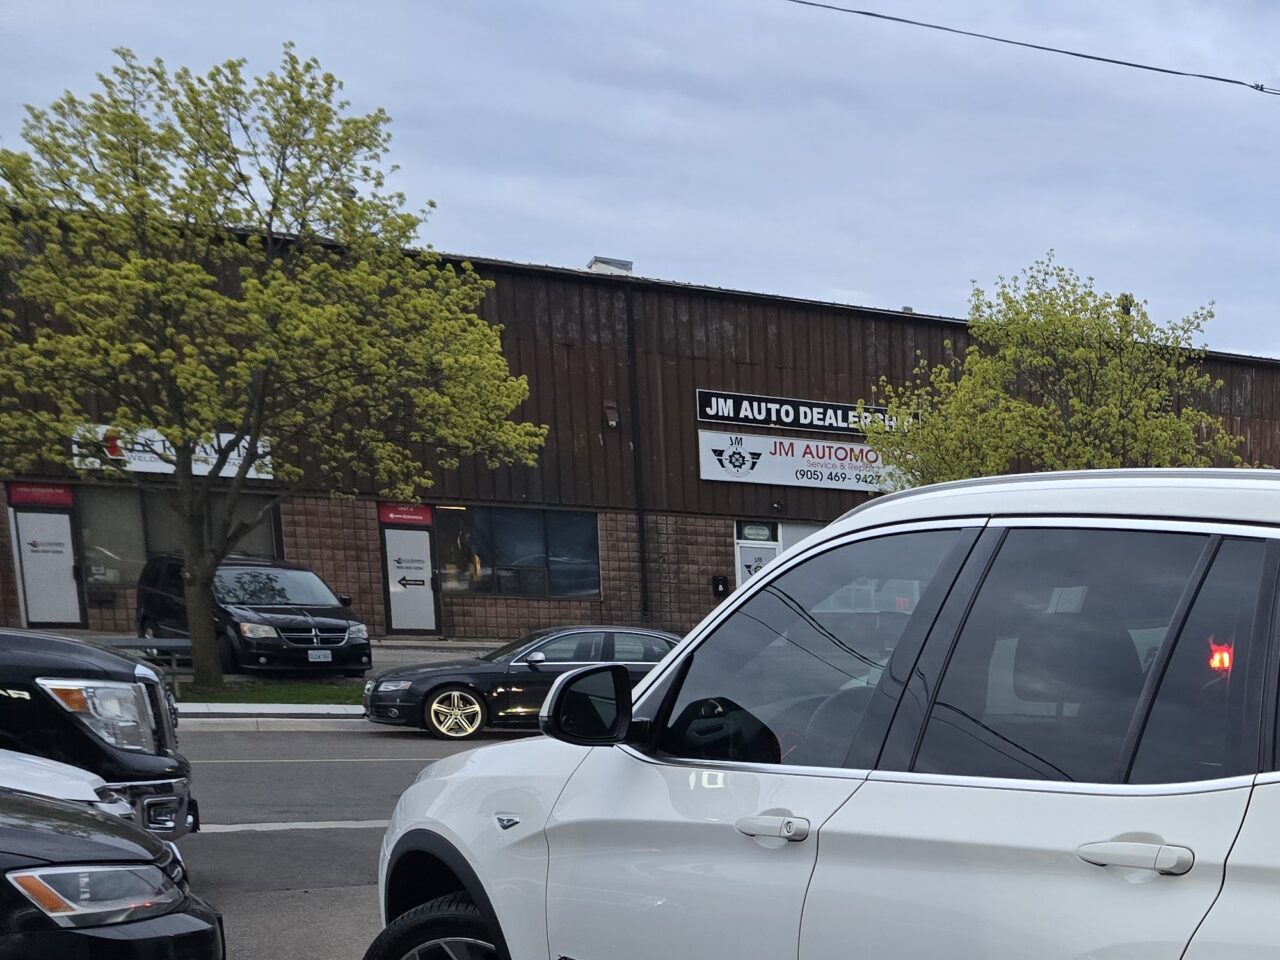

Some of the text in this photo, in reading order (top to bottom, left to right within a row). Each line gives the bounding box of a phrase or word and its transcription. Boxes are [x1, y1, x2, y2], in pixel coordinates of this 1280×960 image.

[706, 397, 913, 433] JM AUTO DEALERSHP
[729, 436, 743, 447] JM
[769, 440, 879, 464] JM AUTOMO
[806, 460, 837, 470] Service
[795, 469, 824, 482] (905)
[827, 471, 852, 482] 469-
